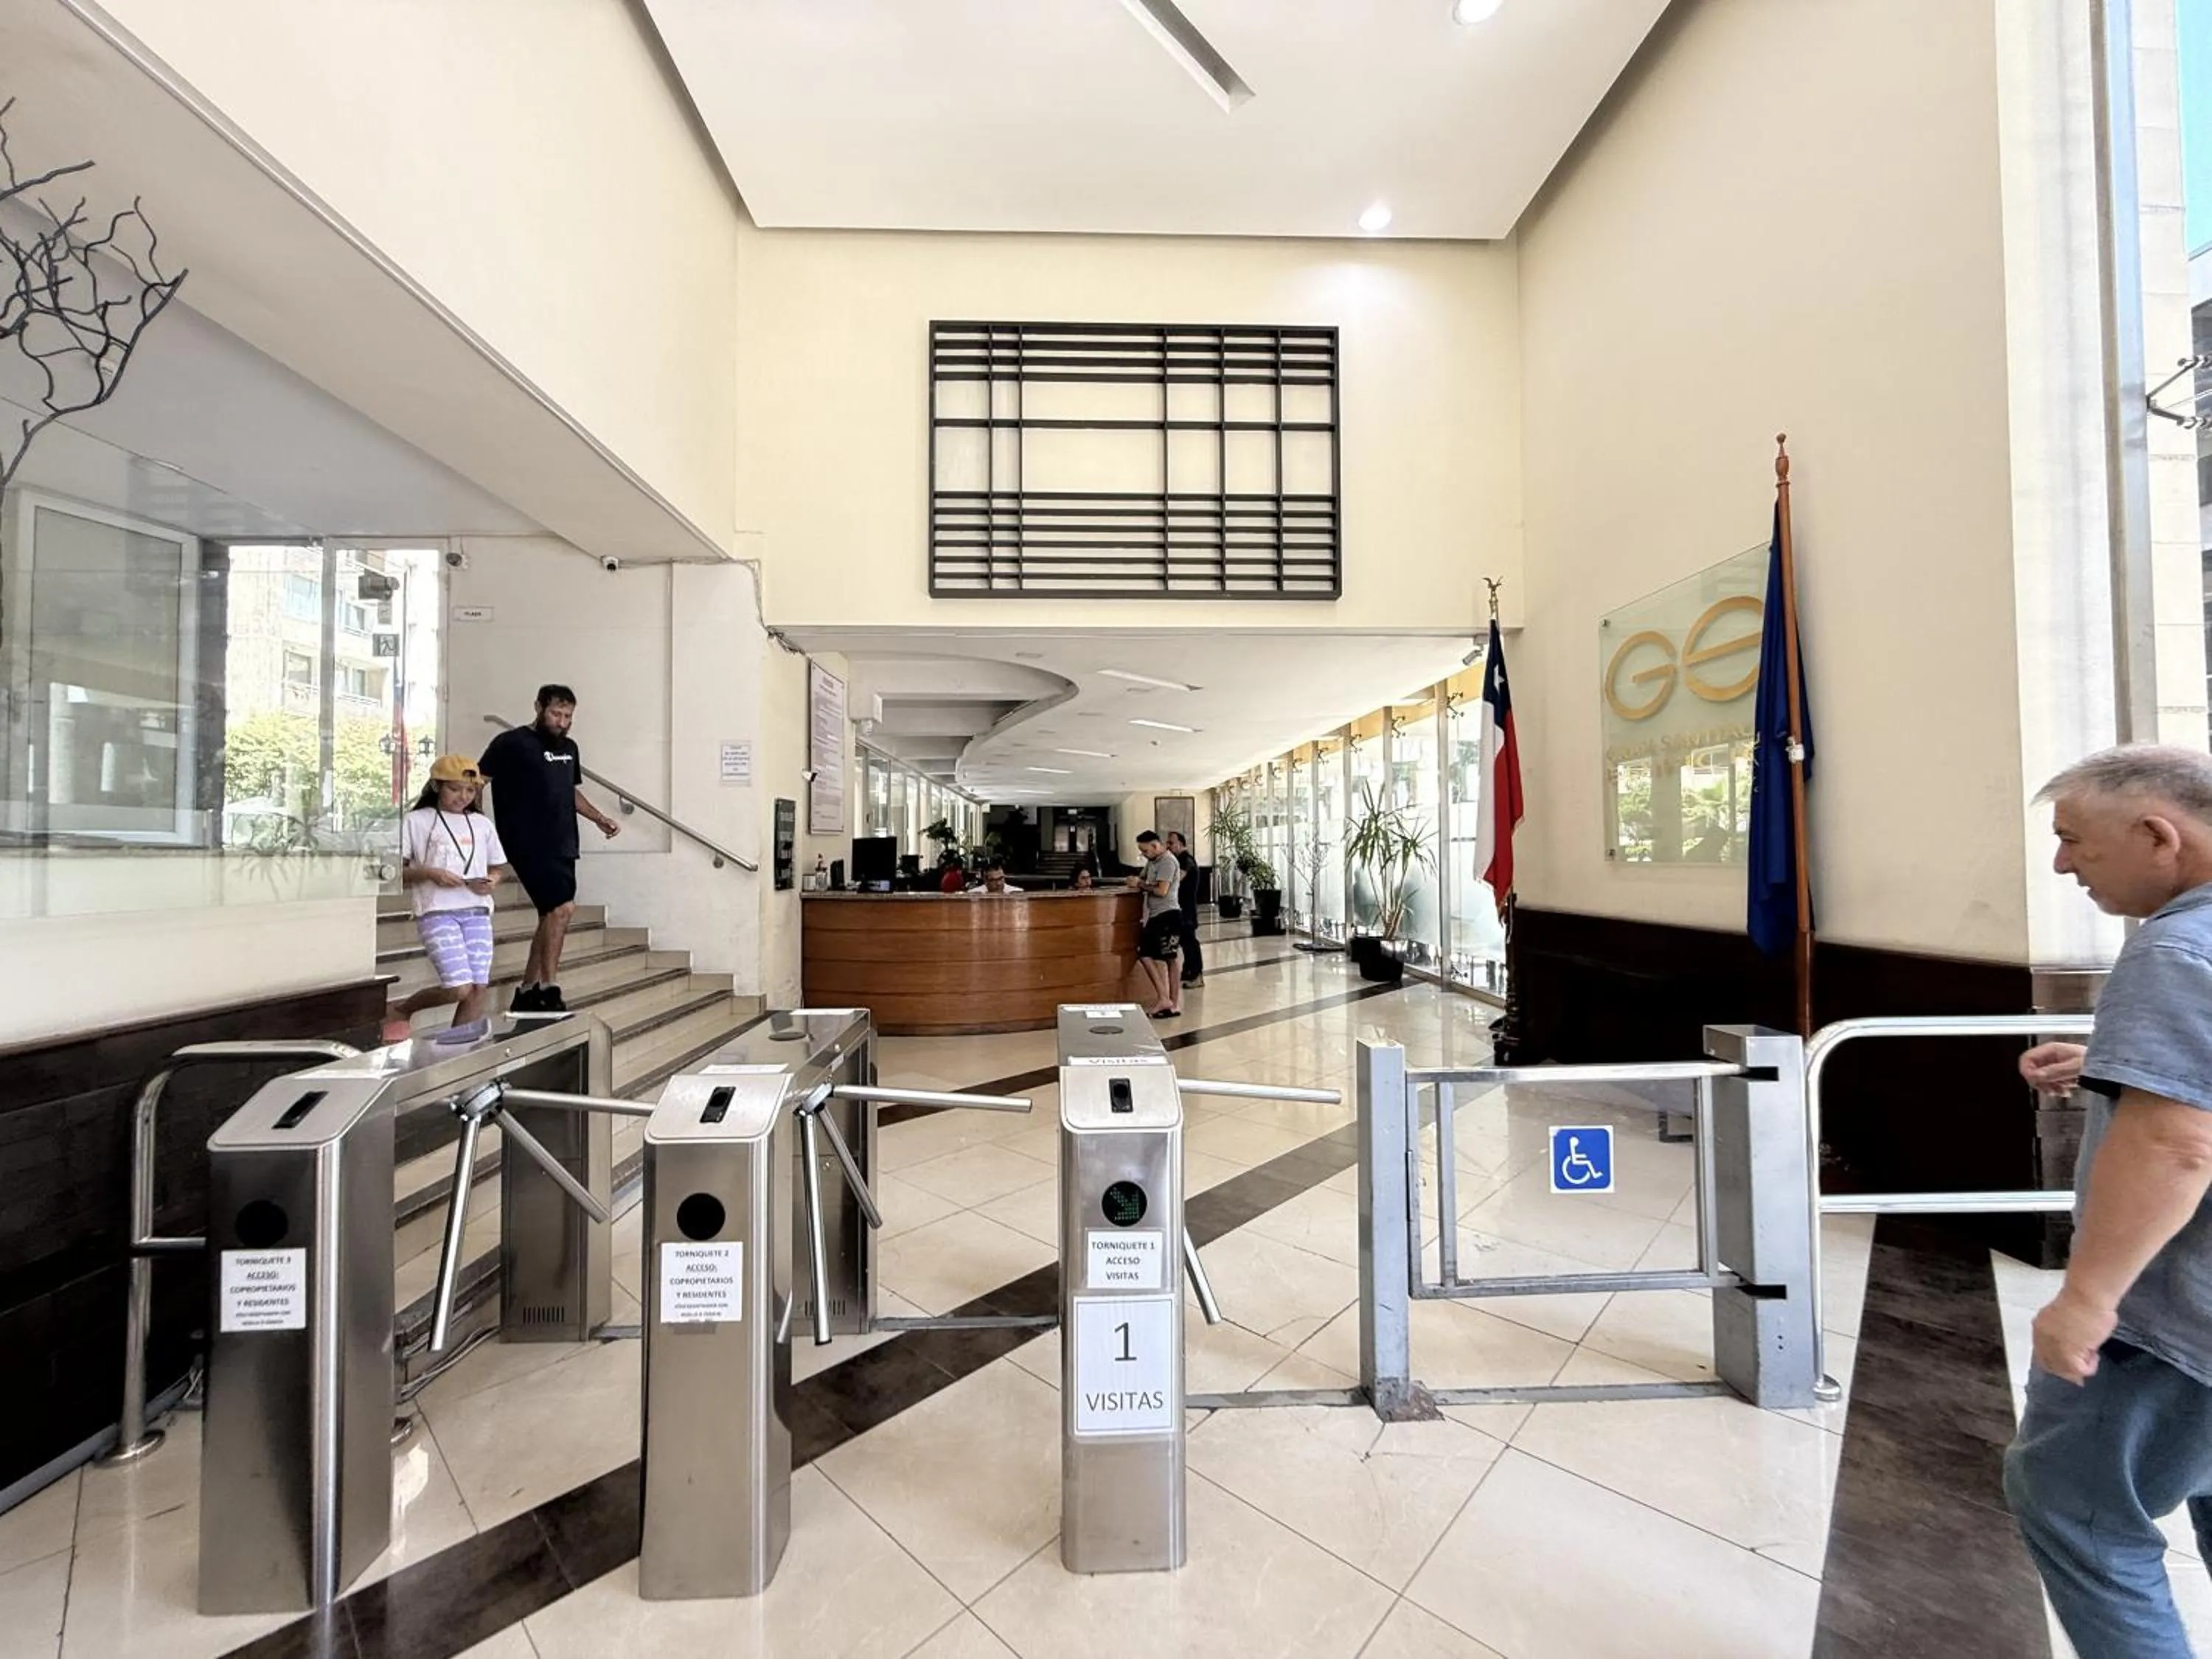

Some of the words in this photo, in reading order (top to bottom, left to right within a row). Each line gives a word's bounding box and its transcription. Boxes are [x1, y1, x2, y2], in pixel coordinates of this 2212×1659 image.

[1091, 1241, 1148, 1251] TORNIQUETE
[1150, 1242, 1155, 1250] 1
[674, 1250, 722, 1259] TORNIQUETE
[1106, 1256, 1141, 1265] ACCESO
[1106, 1271, 1140, 1280] VISITAS
[1114, 1321, 1137, 1361] 1
[1085, 1391, 1164, 1412] VISITAS
